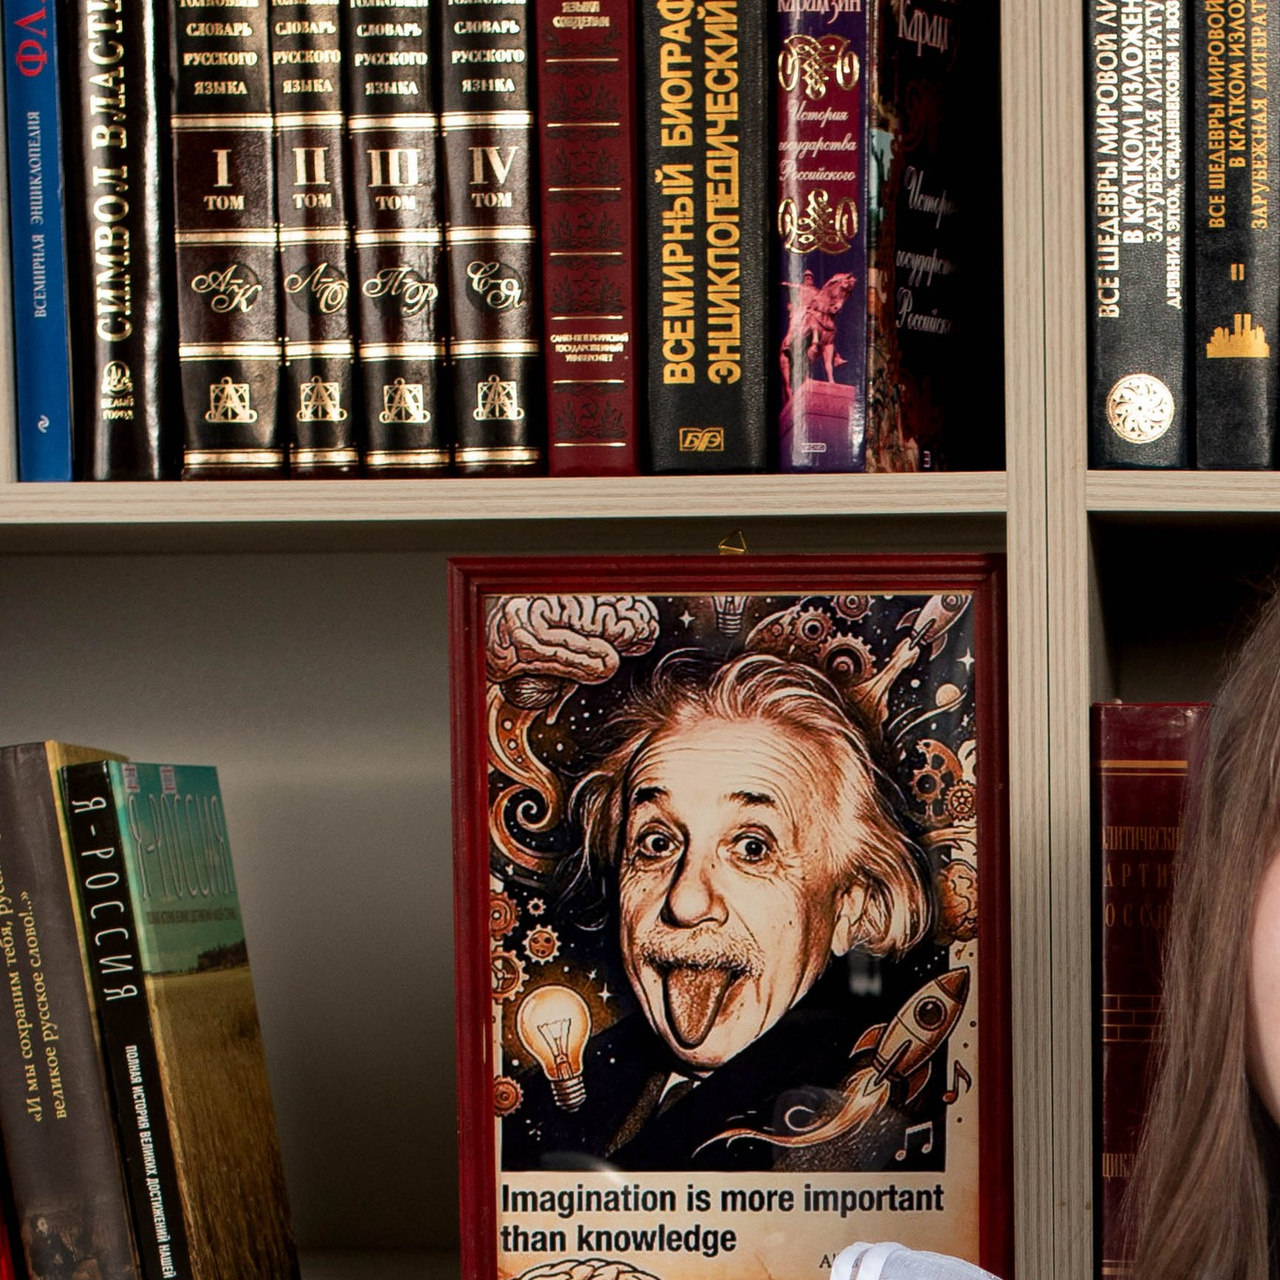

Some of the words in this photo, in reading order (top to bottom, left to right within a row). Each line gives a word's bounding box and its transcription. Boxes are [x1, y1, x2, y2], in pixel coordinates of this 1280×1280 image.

[186, 22, 253, 37] СЛОВАРЬ
[453, 20, 520, 34] СЛОВАРЬ
[1166, 31, 1181, 46] И
[182, 52, 258, 66] РУССКОГО
[451, 49, 525, 64] РУССКОГО
[194, 81, 248, 95] ЯЗЫКА
[462, 79, 515, 93] ЯЗЫКА
[1093, 32, 1119, 154] МИРОВОЙ
[787, 100, 848, 128] История
[1165, 50, 1182, 179] СРЕДНЕВЕКОВЬЯ
[469, 146, 519, 185] IV
[779, 133, 857, 159] государства
[27, 110, 44, 225] ЭНЦИКЛОПЕДИЯ
[213, 149, 232, 188] I
[292, 147, 331, 186] II
[366, 149, 423, 187] III
[779, 160, 856, 182] Российского
[1122, 117, 1145, 223] КРАТКОМ
[1145, 108, 1166, 242] ЗАРУБЕЖНАЯ
[204, 194, 244, 211] ТОМ
[472, 193, 512, 208] ТОМ
[698, 0, 742, 383] ЭНЦИКЛОПЕДИЧЕСКИЙ
[1166, 182, 1182, 232] ЭПОХ,
[1097, 160, 1121, 271] ШЕДЕВРЫ
[93, 166, 132, 343] СИМВОЛ
[1122, 229, 1145, 243] В
[32, 233, 48, 317] ВСЕМИРНАЯ
[655, 163, 696, 384] ВСЕМИРНЫЙ
[1166, 235, 1183, 309] ДРЕВНИХ
[1098, 276, 1121, 317] ВСЕ
[0, 920, 17, 967] тебя,
[9, 971, 34, 1059] сохраним
[33, 971, 58, 1041] русское
[24, 1063, 39, 1091] мы
[45, 1046, 68, 1118] великое
[125, 1045, 142, 1085] ПОЛНАЯ
[131, 1085, 150, 1130] ИСТОРИЯ
[138, 1131, 157, 1177] ВЕЛИКИХ
[145, 1178, 170, 1244] ДОСТИЖЕНИЙ
[503, 1184, 676, 1219] Imagination
[687, 1184, 711, 1212] is
[722, 1190, 795, 1212] more
[805, 1184, 945, 1219] important
[500, 1225, 567, 1253] than
[578, 1224, 737, 1258] knowledge
[158, 1244, 176, 1280] НАШЕЙ
